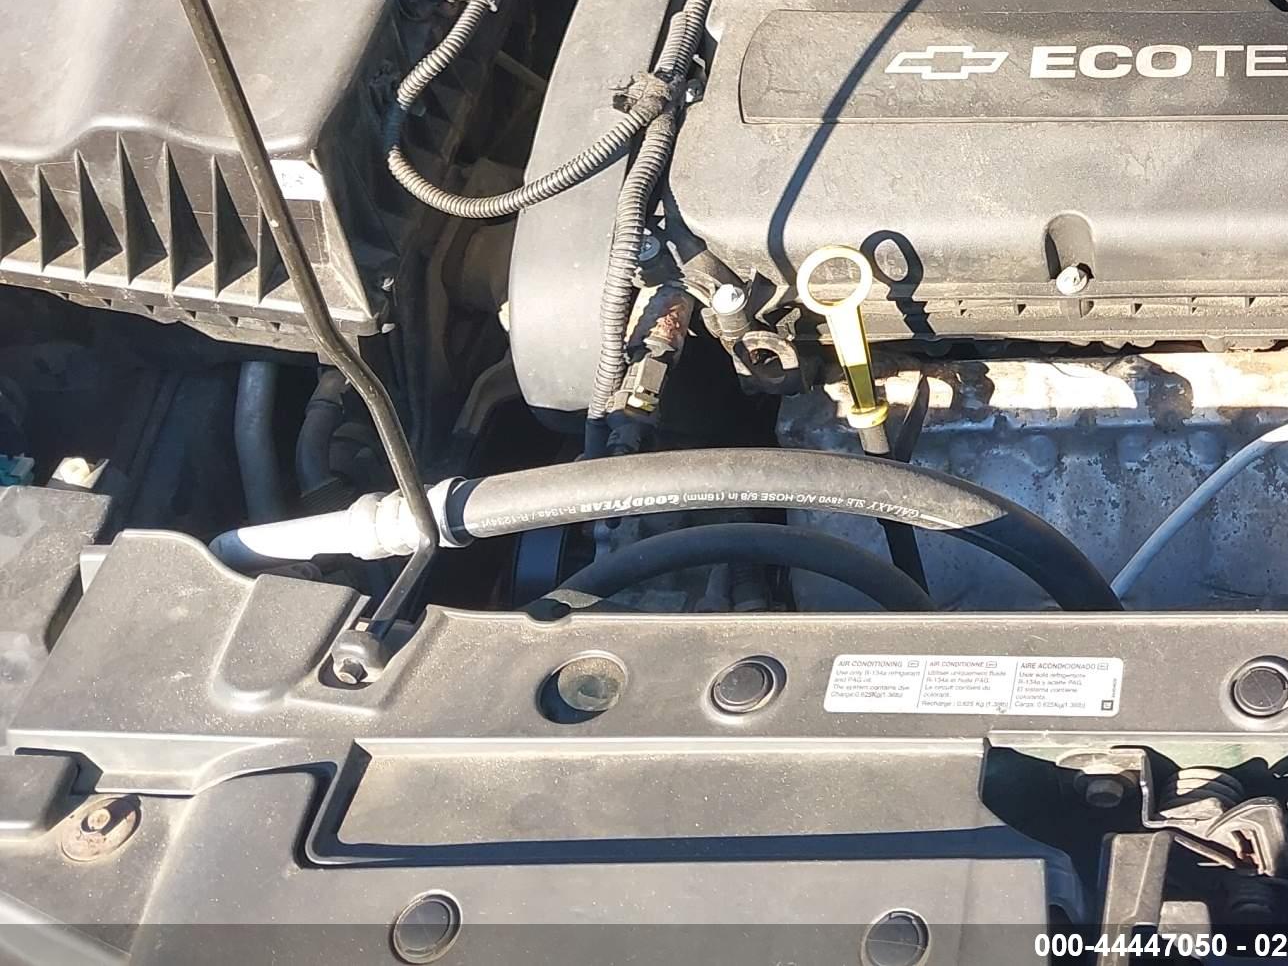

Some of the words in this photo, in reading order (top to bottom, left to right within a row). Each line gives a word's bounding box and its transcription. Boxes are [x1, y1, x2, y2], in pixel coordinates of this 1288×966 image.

[580, 494, 681, 513] GOODYEAR
[684, 491, 725, 503] (16mm)
[728, 492, 739, 502] in
[760, 492, 794, 503] HOSE
[537, 505, 577, 519] R-134a
[867, 501, 920, 518] GALAXY
